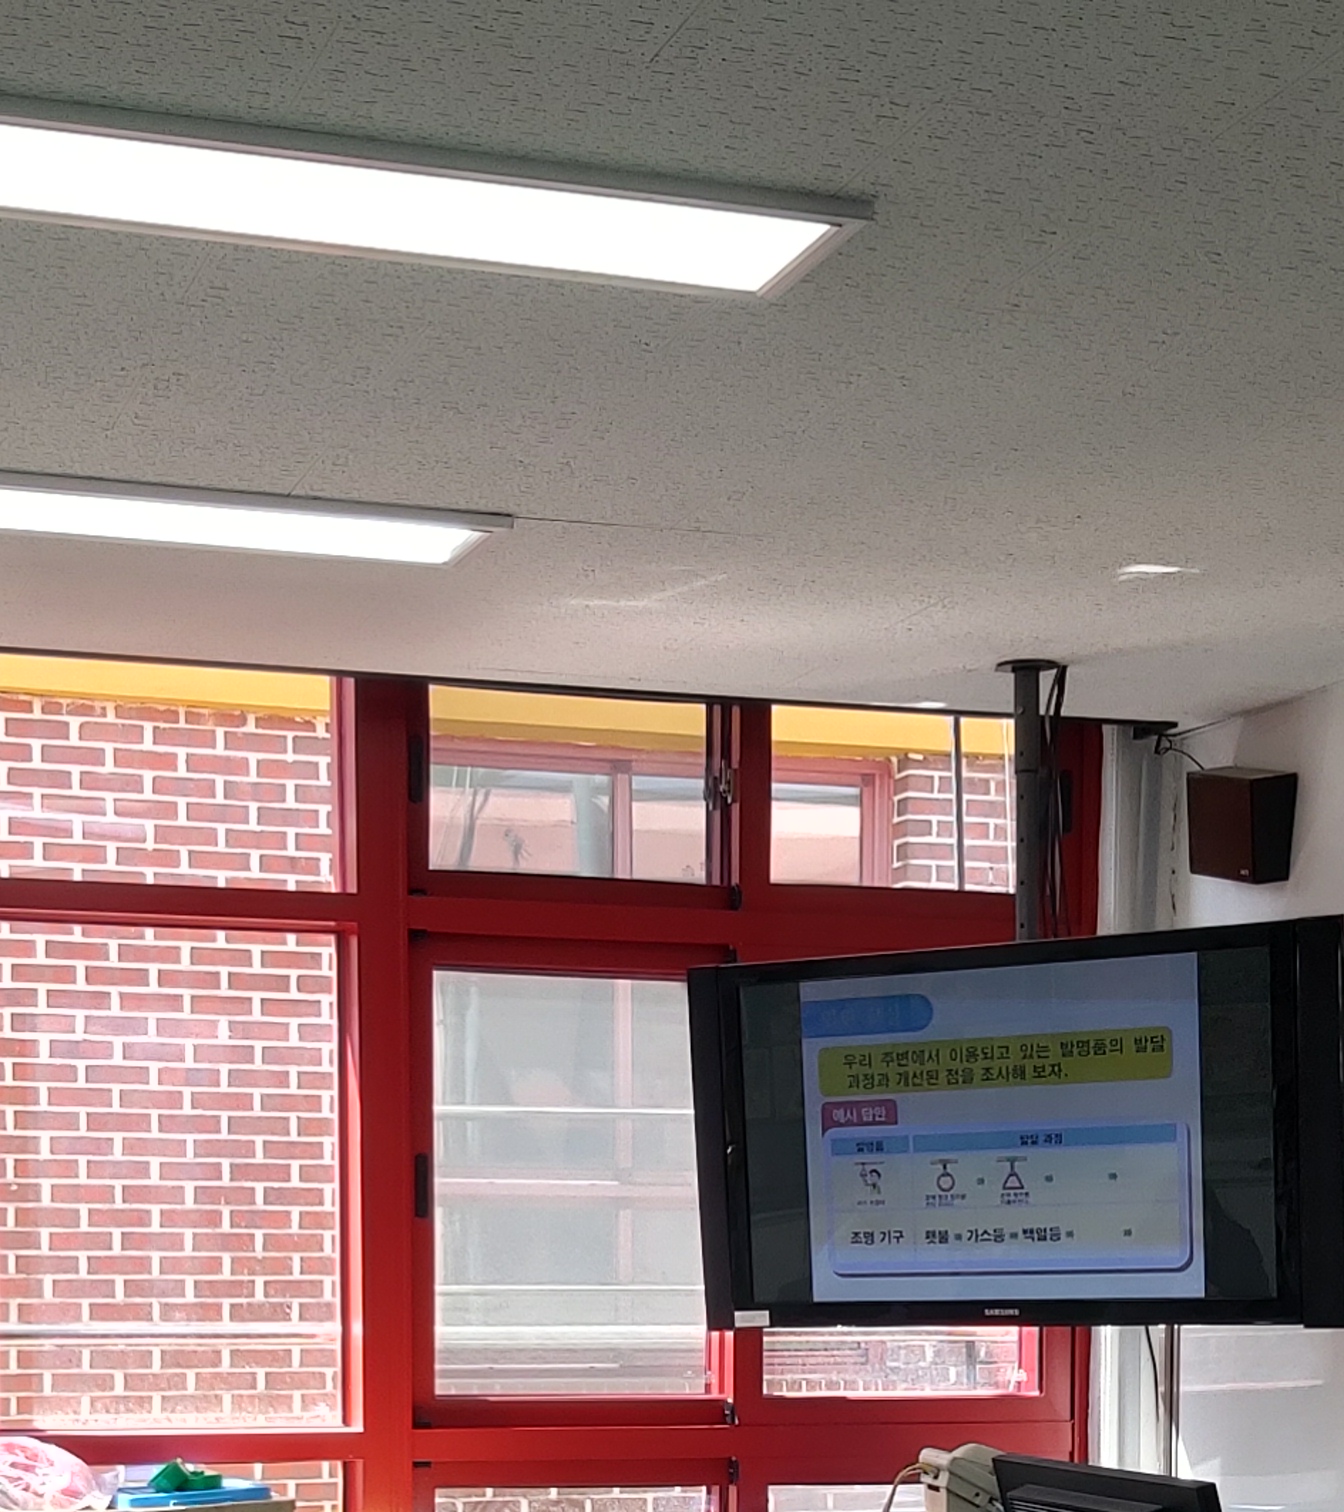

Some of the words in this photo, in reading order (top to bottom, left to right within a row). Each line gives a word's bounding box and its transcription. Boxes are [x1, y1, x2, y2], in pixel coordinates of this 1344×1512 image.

[843, 1052, 872, 1070] 우리
[880, 1049, 940, 1067] 주변에서
[949, 1045, 1011, 1064] 이용되고
[1020, 1043, 1052, 1060] 있는
[1060, 1037, 1124, 1058] 발명품의
[1134, 1034, 1166, 1053] 발달
[847, 1073, 890, 1090] 과정과
[896, 1070, 939, 1087] 개선된
[945, 1067, 974, 1085] 점을
[981, 1063, 1027, 1082] 조사해
[1032, 1062, 1069, 1079] 보자.
[850, 1231, 875, 1246] 조명
[880, 1230, 905, 1245] 기구
[966, 1228, 1005, 1244] 가스등
[1022, 1226, 1061, 1242] 백열등
